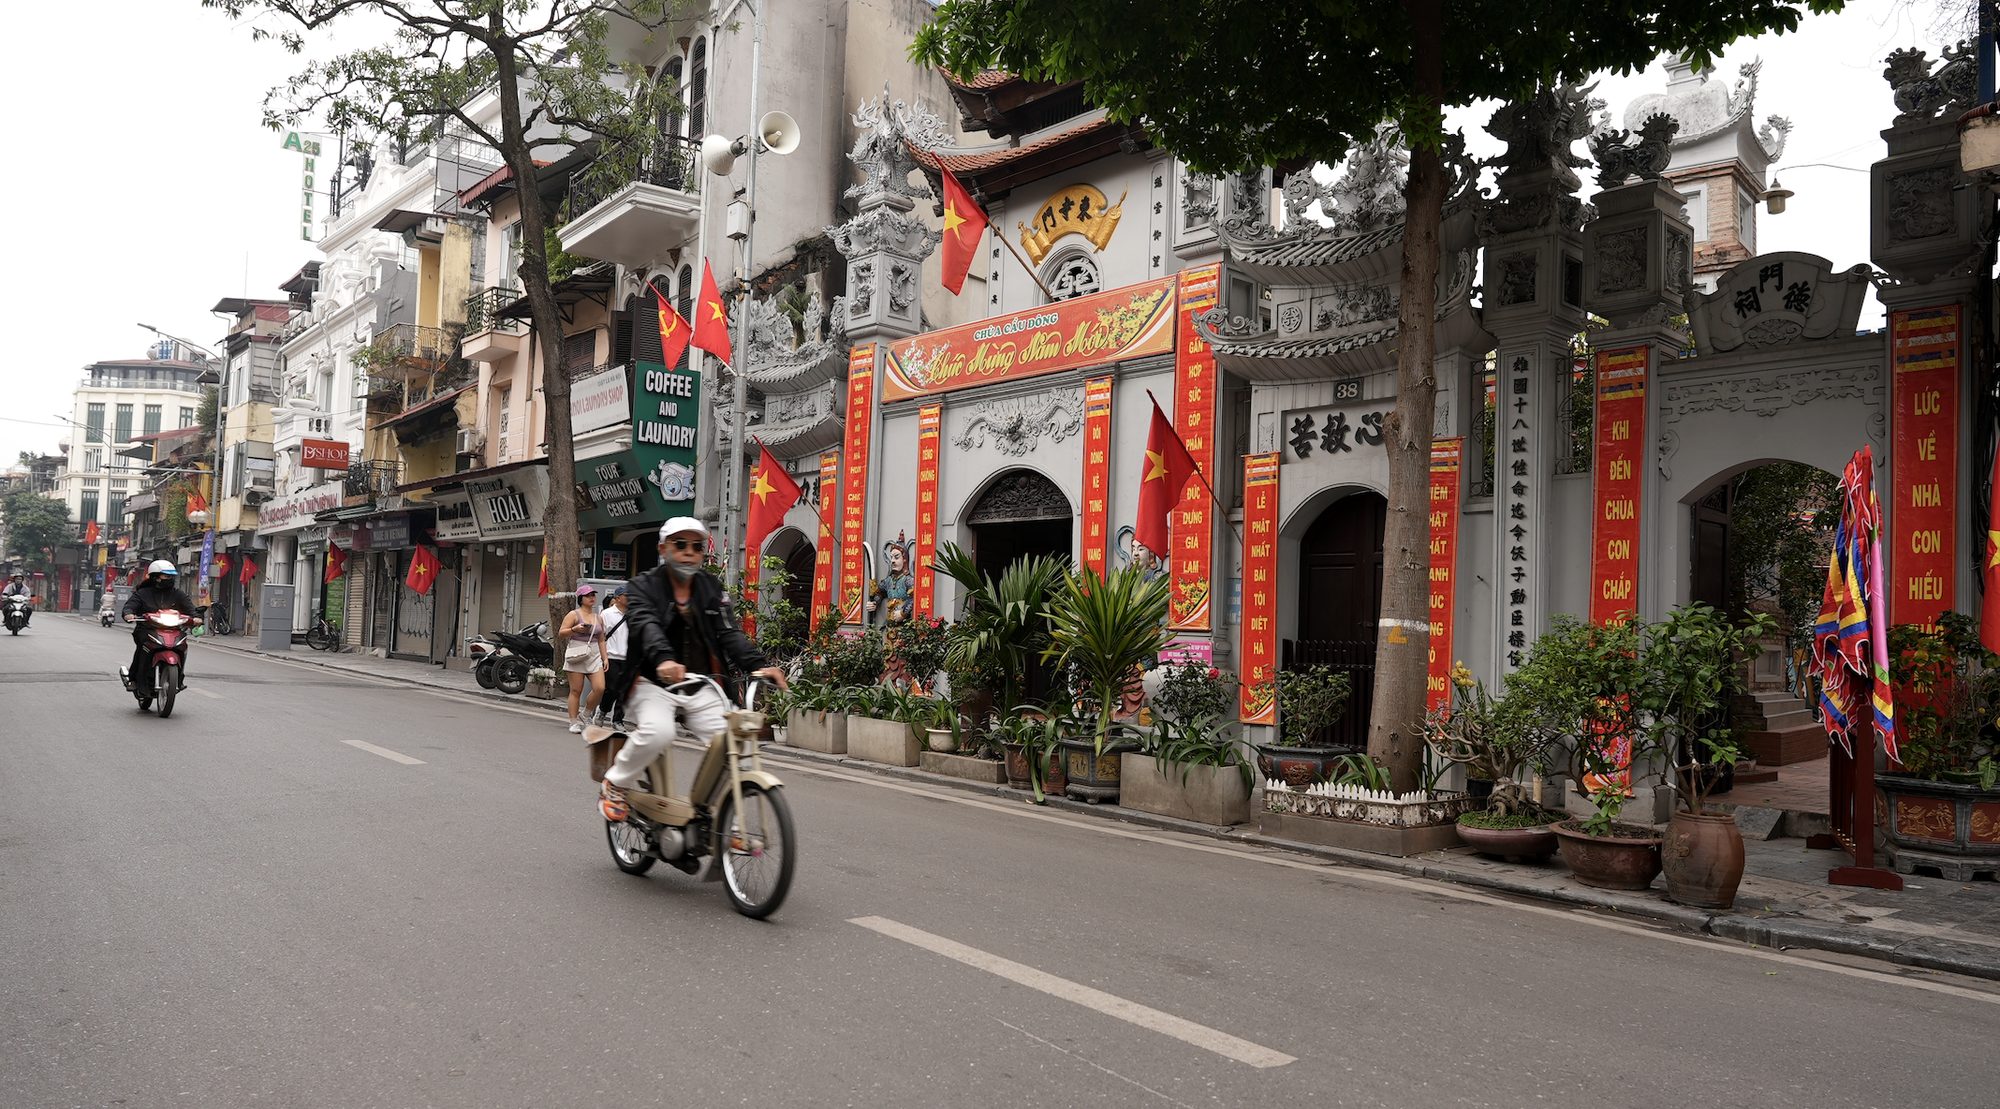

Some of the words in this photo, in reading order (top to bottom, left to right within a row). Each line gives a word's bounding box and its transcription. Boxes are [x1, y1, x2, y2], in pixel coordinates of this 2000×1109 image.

[303, 157, 315, 241] HOTEL
[1188, 362, 1203, 381] HỢP
[645, 369, 693, 398] COFFEE
[1336, 383, 1358, 399] 38
[608, 384, 624, 406] SHOP
[1914, 385, 1941, 416] LÚC
[658, 400, 678, 417] AND
[1188, 411, 1201, 427] GÓP
[637, 420, 696, 448] LAUNDRY
[1612, 419, 1629, 441] KHI
[1917, 429, 1937, 461] VỀ
[595, 465, 620, 481] TOUR
[1609, 454, 1631, 481] ĐẾN
[588, 478, 643, 502] INFORMATION
[1912, 477, 1941, 508] NHÀ
[606, 499, 639, 518] CENTRE
[1256, 492, 1266, 510] LỄ
[1605, 494, 1634, 521] CHÙA
[1251, 519, 1271, 537] PHẬT
[1185, 534, 1199, 549] GIÀ
[1251, 541, 1271, 558] NHẤT
[1607, 539, 1630, 560] CON
[1911, 530, 1941, 553] CON
[1183, 561, 1199, 573] LAM
[1253, 566, 1266, 582] BÁI
[1602, 570, 1631, 600] CHẮP
[1908, 568, 1943, 601] HIẾU
[1253, 590, 1266, 610] TỘI
[1250, 613, 1268, 634] DIỆT
[1253, 638, 1264, 655] HÀ
[1252, 665, 1263, 680] SA
